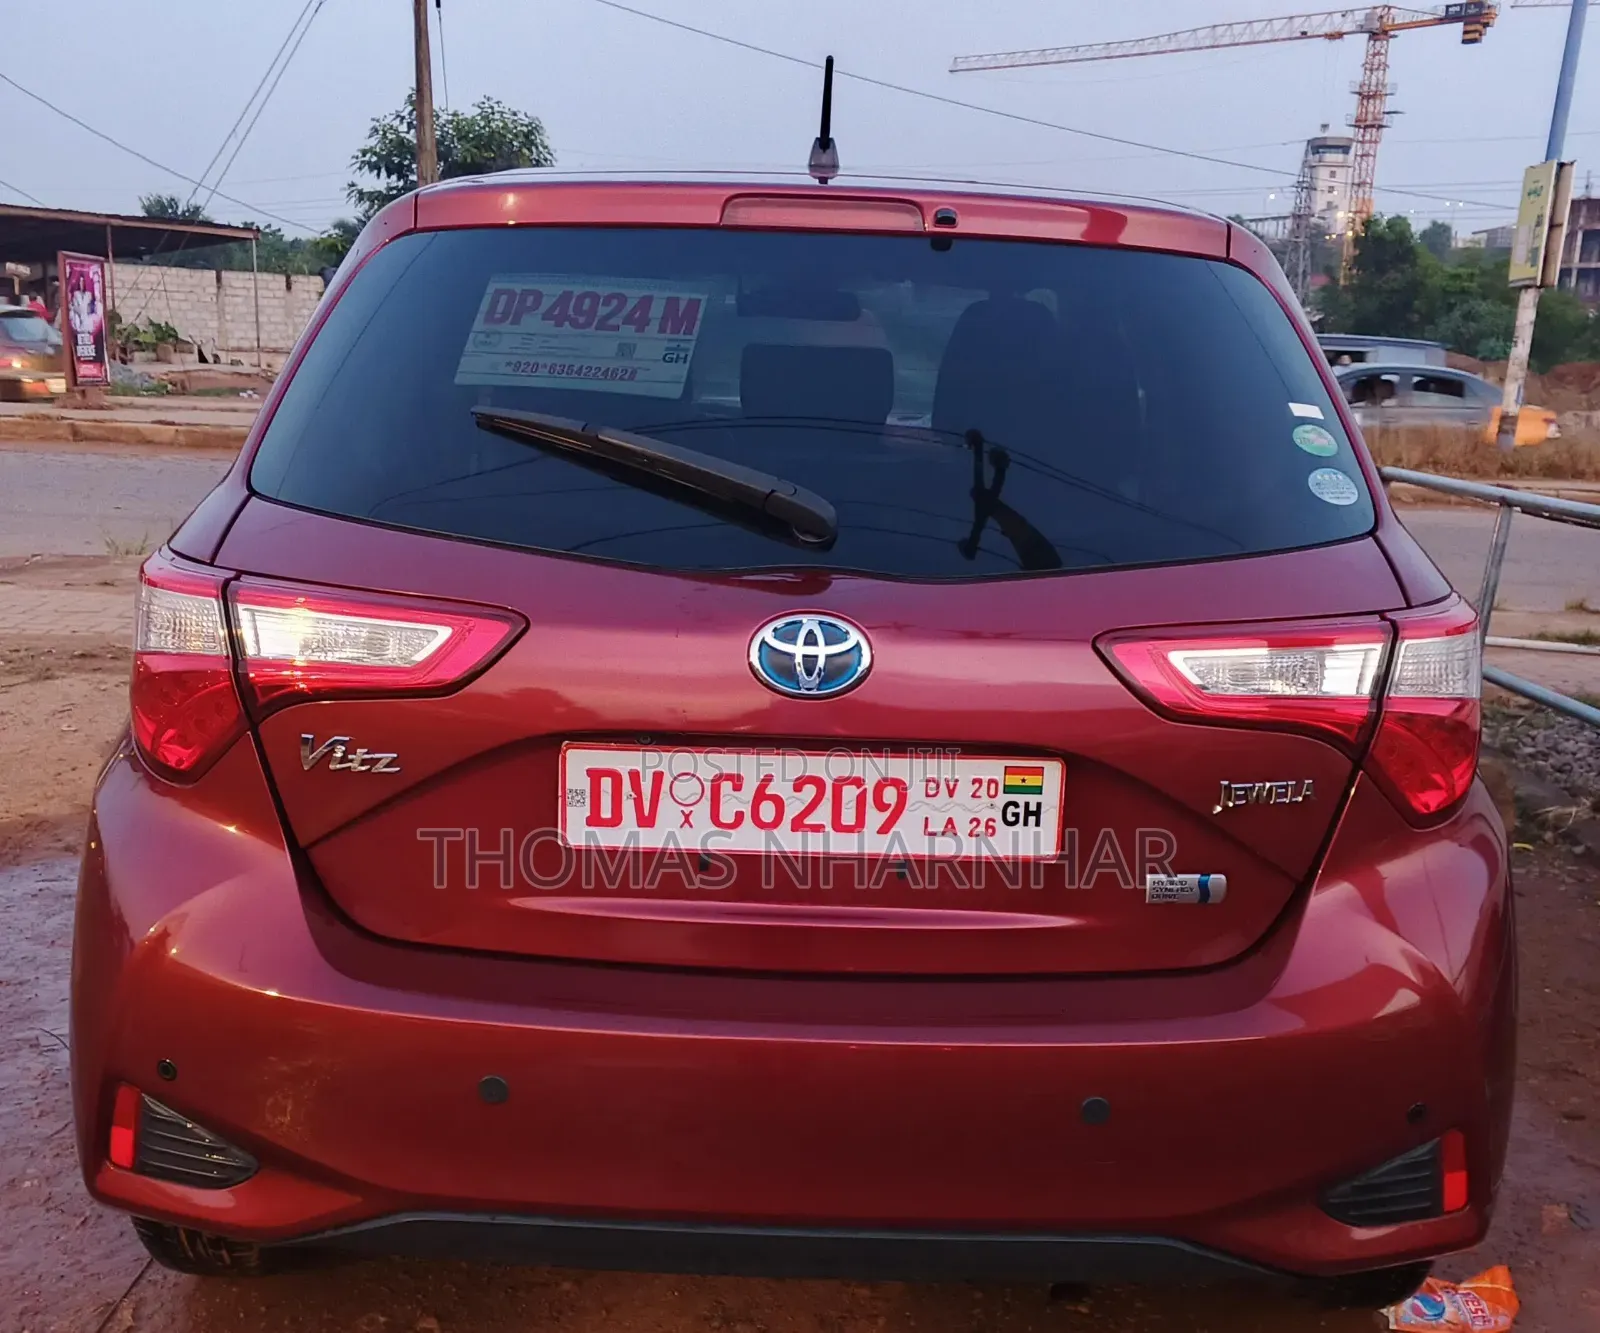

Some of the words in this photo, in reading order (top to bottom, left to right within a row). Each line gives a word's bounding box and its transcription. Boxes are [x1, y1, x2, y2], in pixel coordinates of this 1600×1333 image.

[484, 288, 543, 326] DP
[541, 290, 654, 333] 4924
[657, 295, 702, 336] M
[662, 352, 689, 364] GH
[301, 733, 401, 773] Vitz
[585, 767, 665, 829] DV
[710, 772, 909, 836] C6209
[924, 777, 960, 799] DV
[971, 777, 1000, 799] 20
[1212, 779, 1318, 815] JEWELA
[923, 816, 959, 837] LA
[968, 817, 997, 838] 26
[1001, 800, 1042, 828] GH
